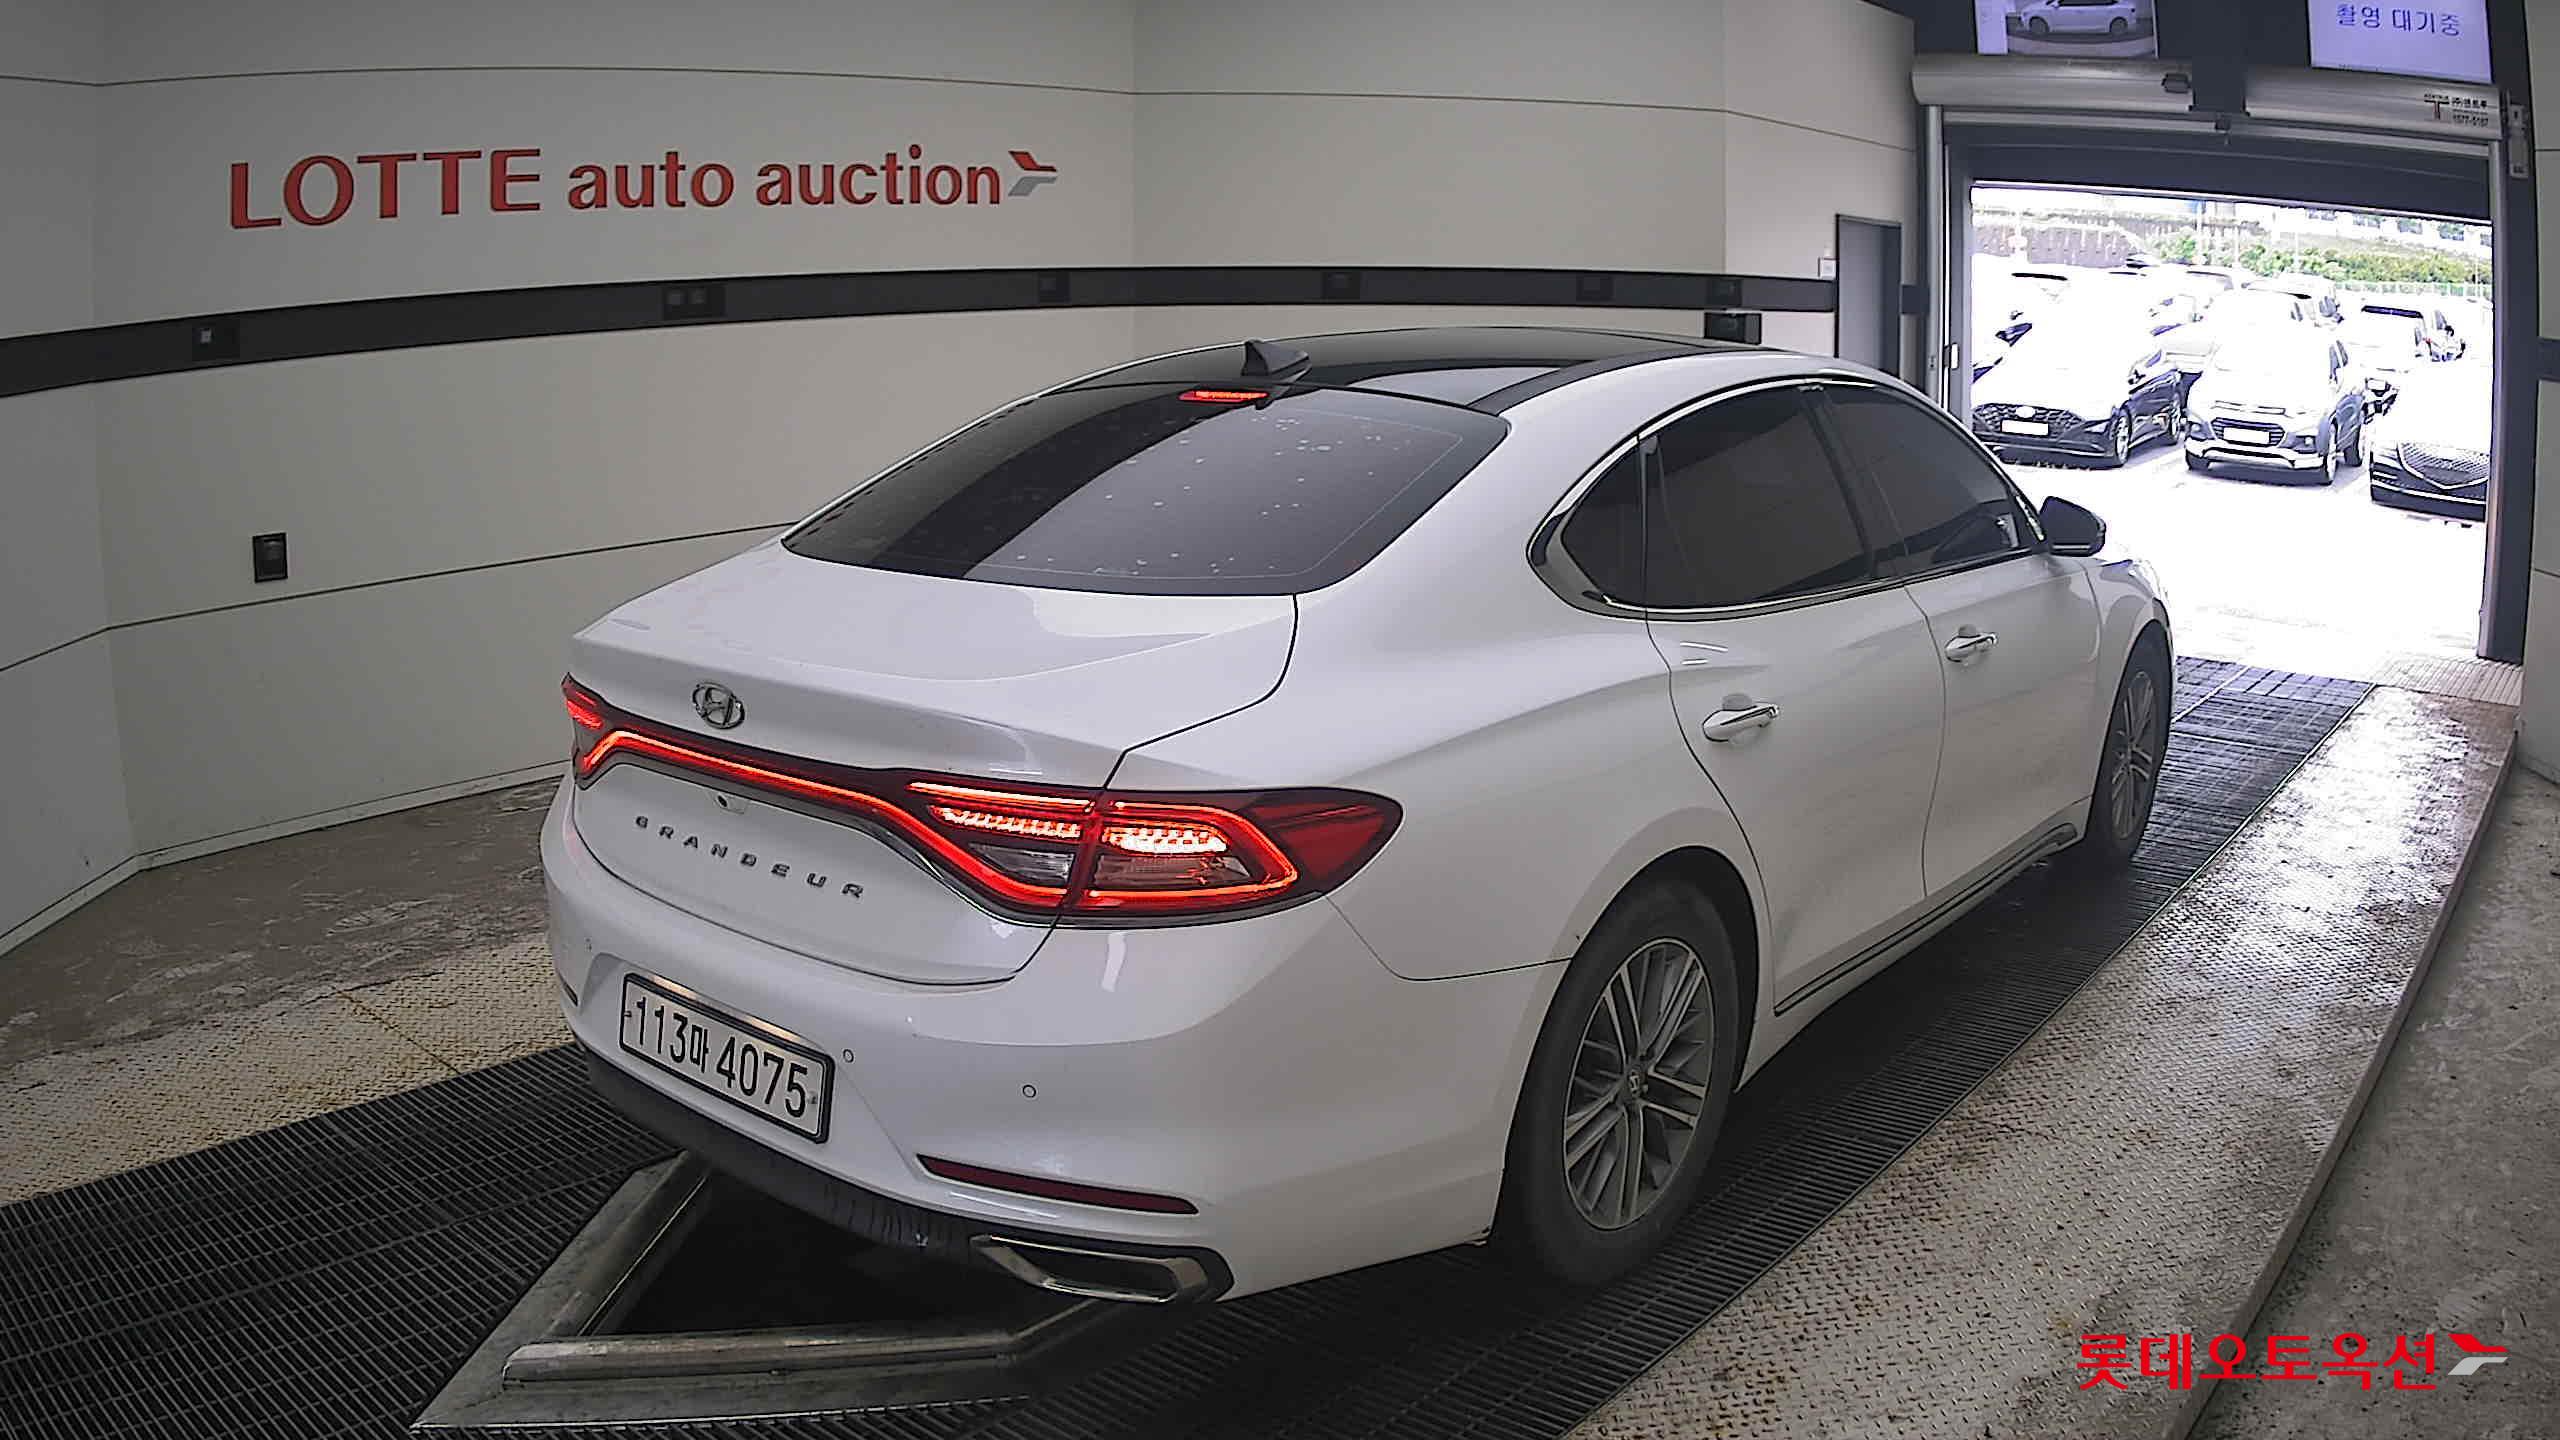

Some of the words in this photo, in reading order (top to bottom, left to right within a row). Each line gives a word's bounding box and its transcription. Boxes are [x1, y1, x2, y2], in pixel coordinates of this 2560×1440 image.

[2337, 4, 2381, 29] 촬영
[2392, 9, 2460, 36] 대기중
[231, 149, 541, 229] LOTTE
[568, 150, 734, 209] auto
[755, 144, 1001, 206] auction
[635, 815, 864, 899] GRANDEUR
